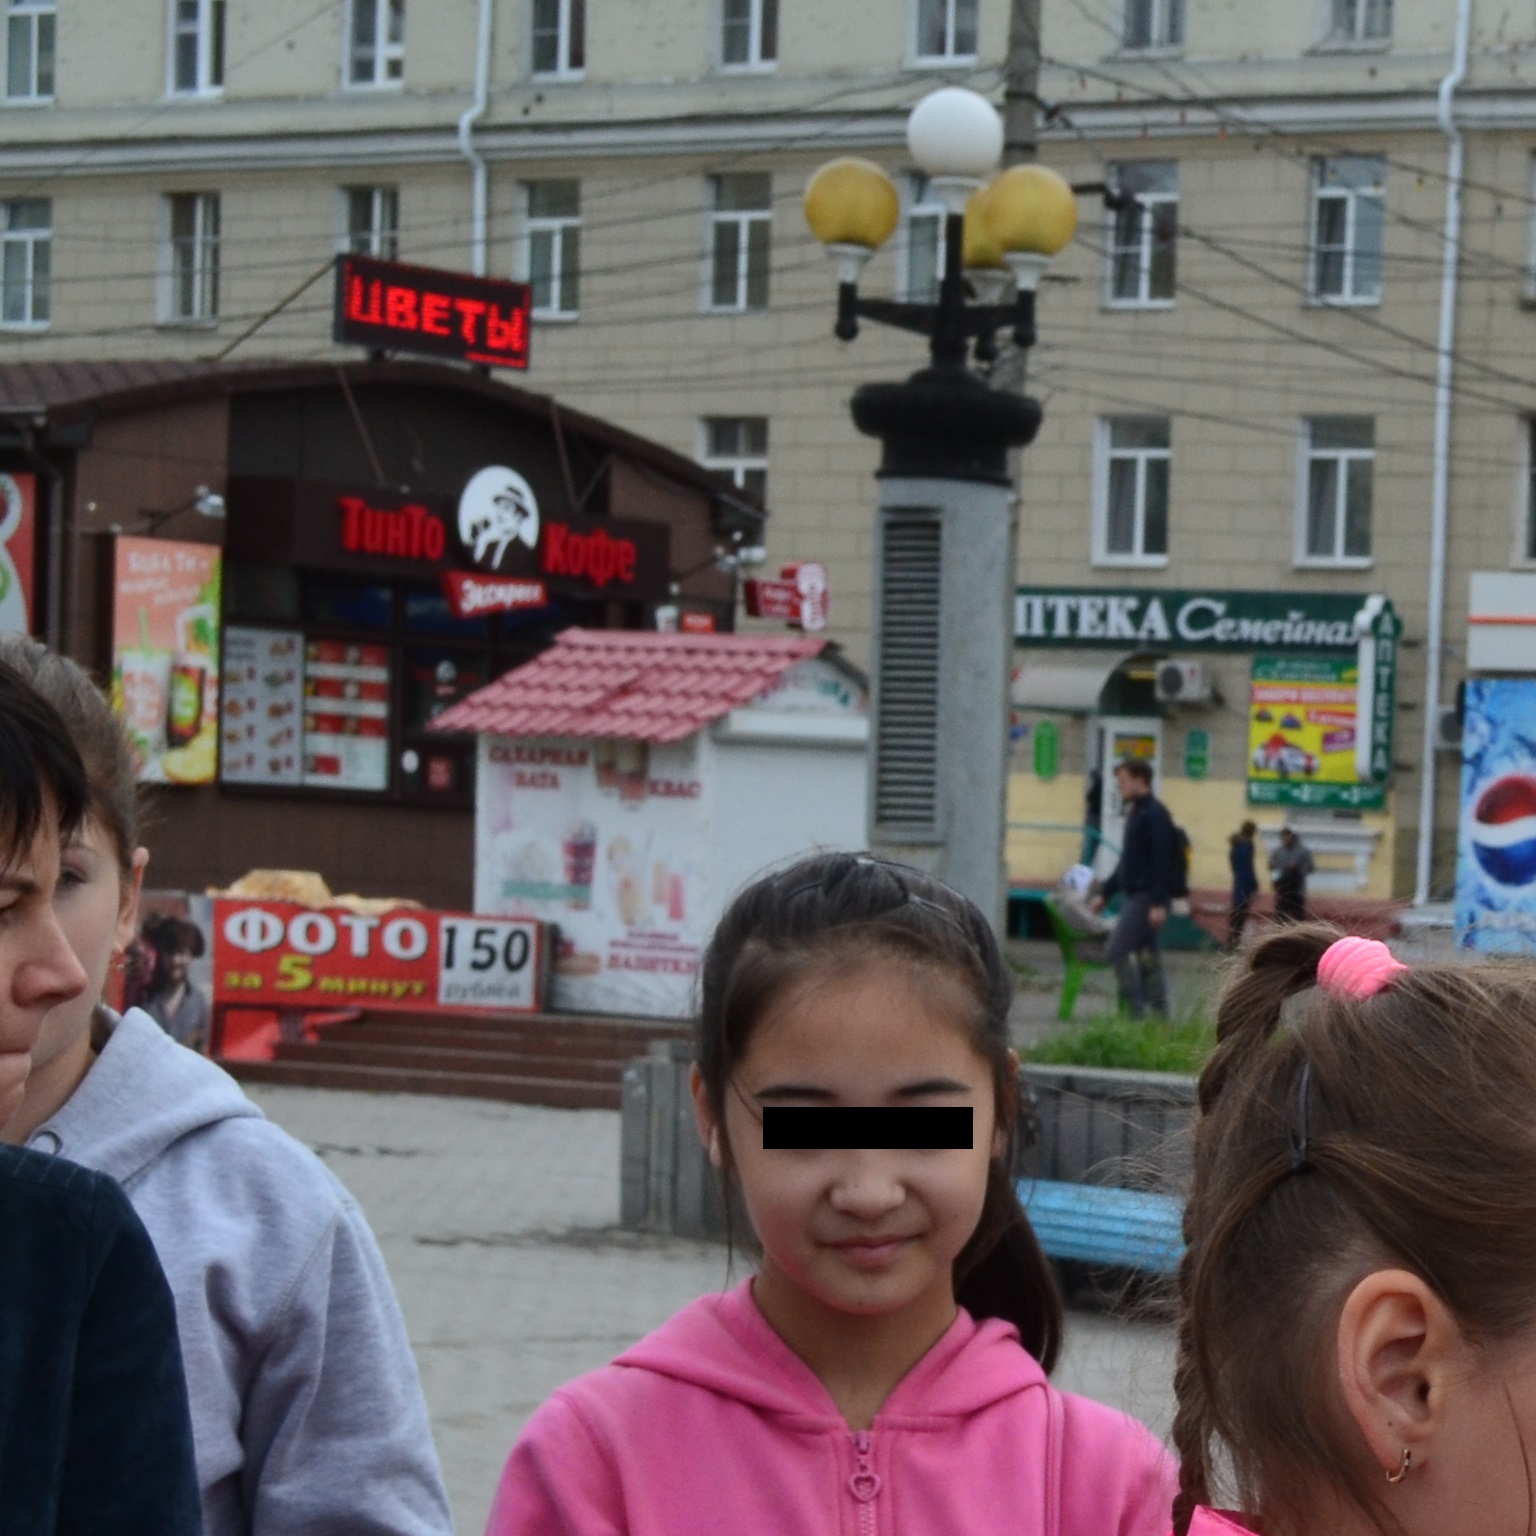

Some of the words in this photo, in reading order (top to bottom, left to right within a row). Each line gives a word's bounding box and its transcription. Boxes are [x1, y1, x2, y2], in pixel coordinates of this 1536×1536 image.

[351, 275, 523, 351] ЦВЕТЫ
[543, 521, 637, 587] Кофе
[1014, 595, 1172, 641] ПТЕКА
[1374, 612, 1395, 769] АПТЕКА
[224, 907, 428, 960] ФОТО
[444, 926, 530, 972] 150
[225, 972, 262, 990] за
[275, 954, 314, 992] 5
[319, 974, 426, 998] минут
